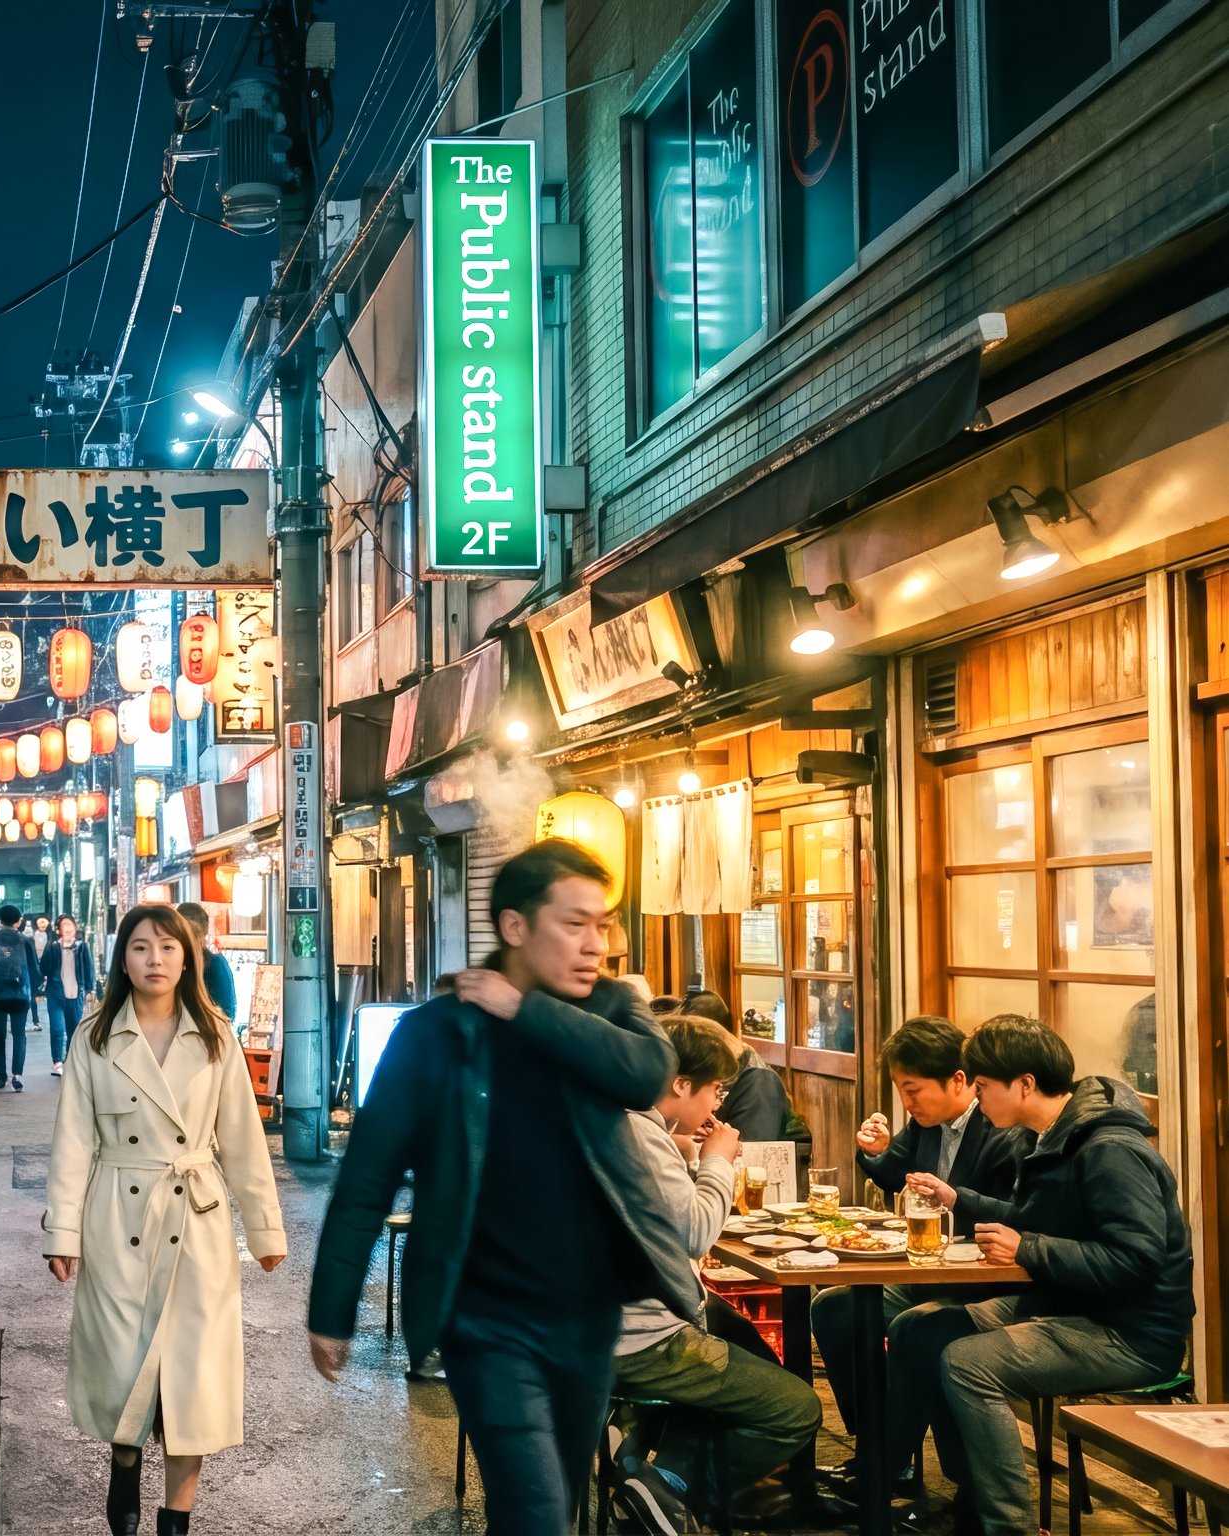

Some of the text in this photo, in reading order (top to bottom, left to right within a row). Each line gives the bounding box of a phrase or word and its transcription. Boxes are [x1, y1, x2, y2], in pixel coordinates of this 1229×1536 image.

[864, 0, 947, 114] stand
[450, 156, 513, 184] The
[460, 189, 514, 505] Public stand
[461, 521, 512, 556] 2F
